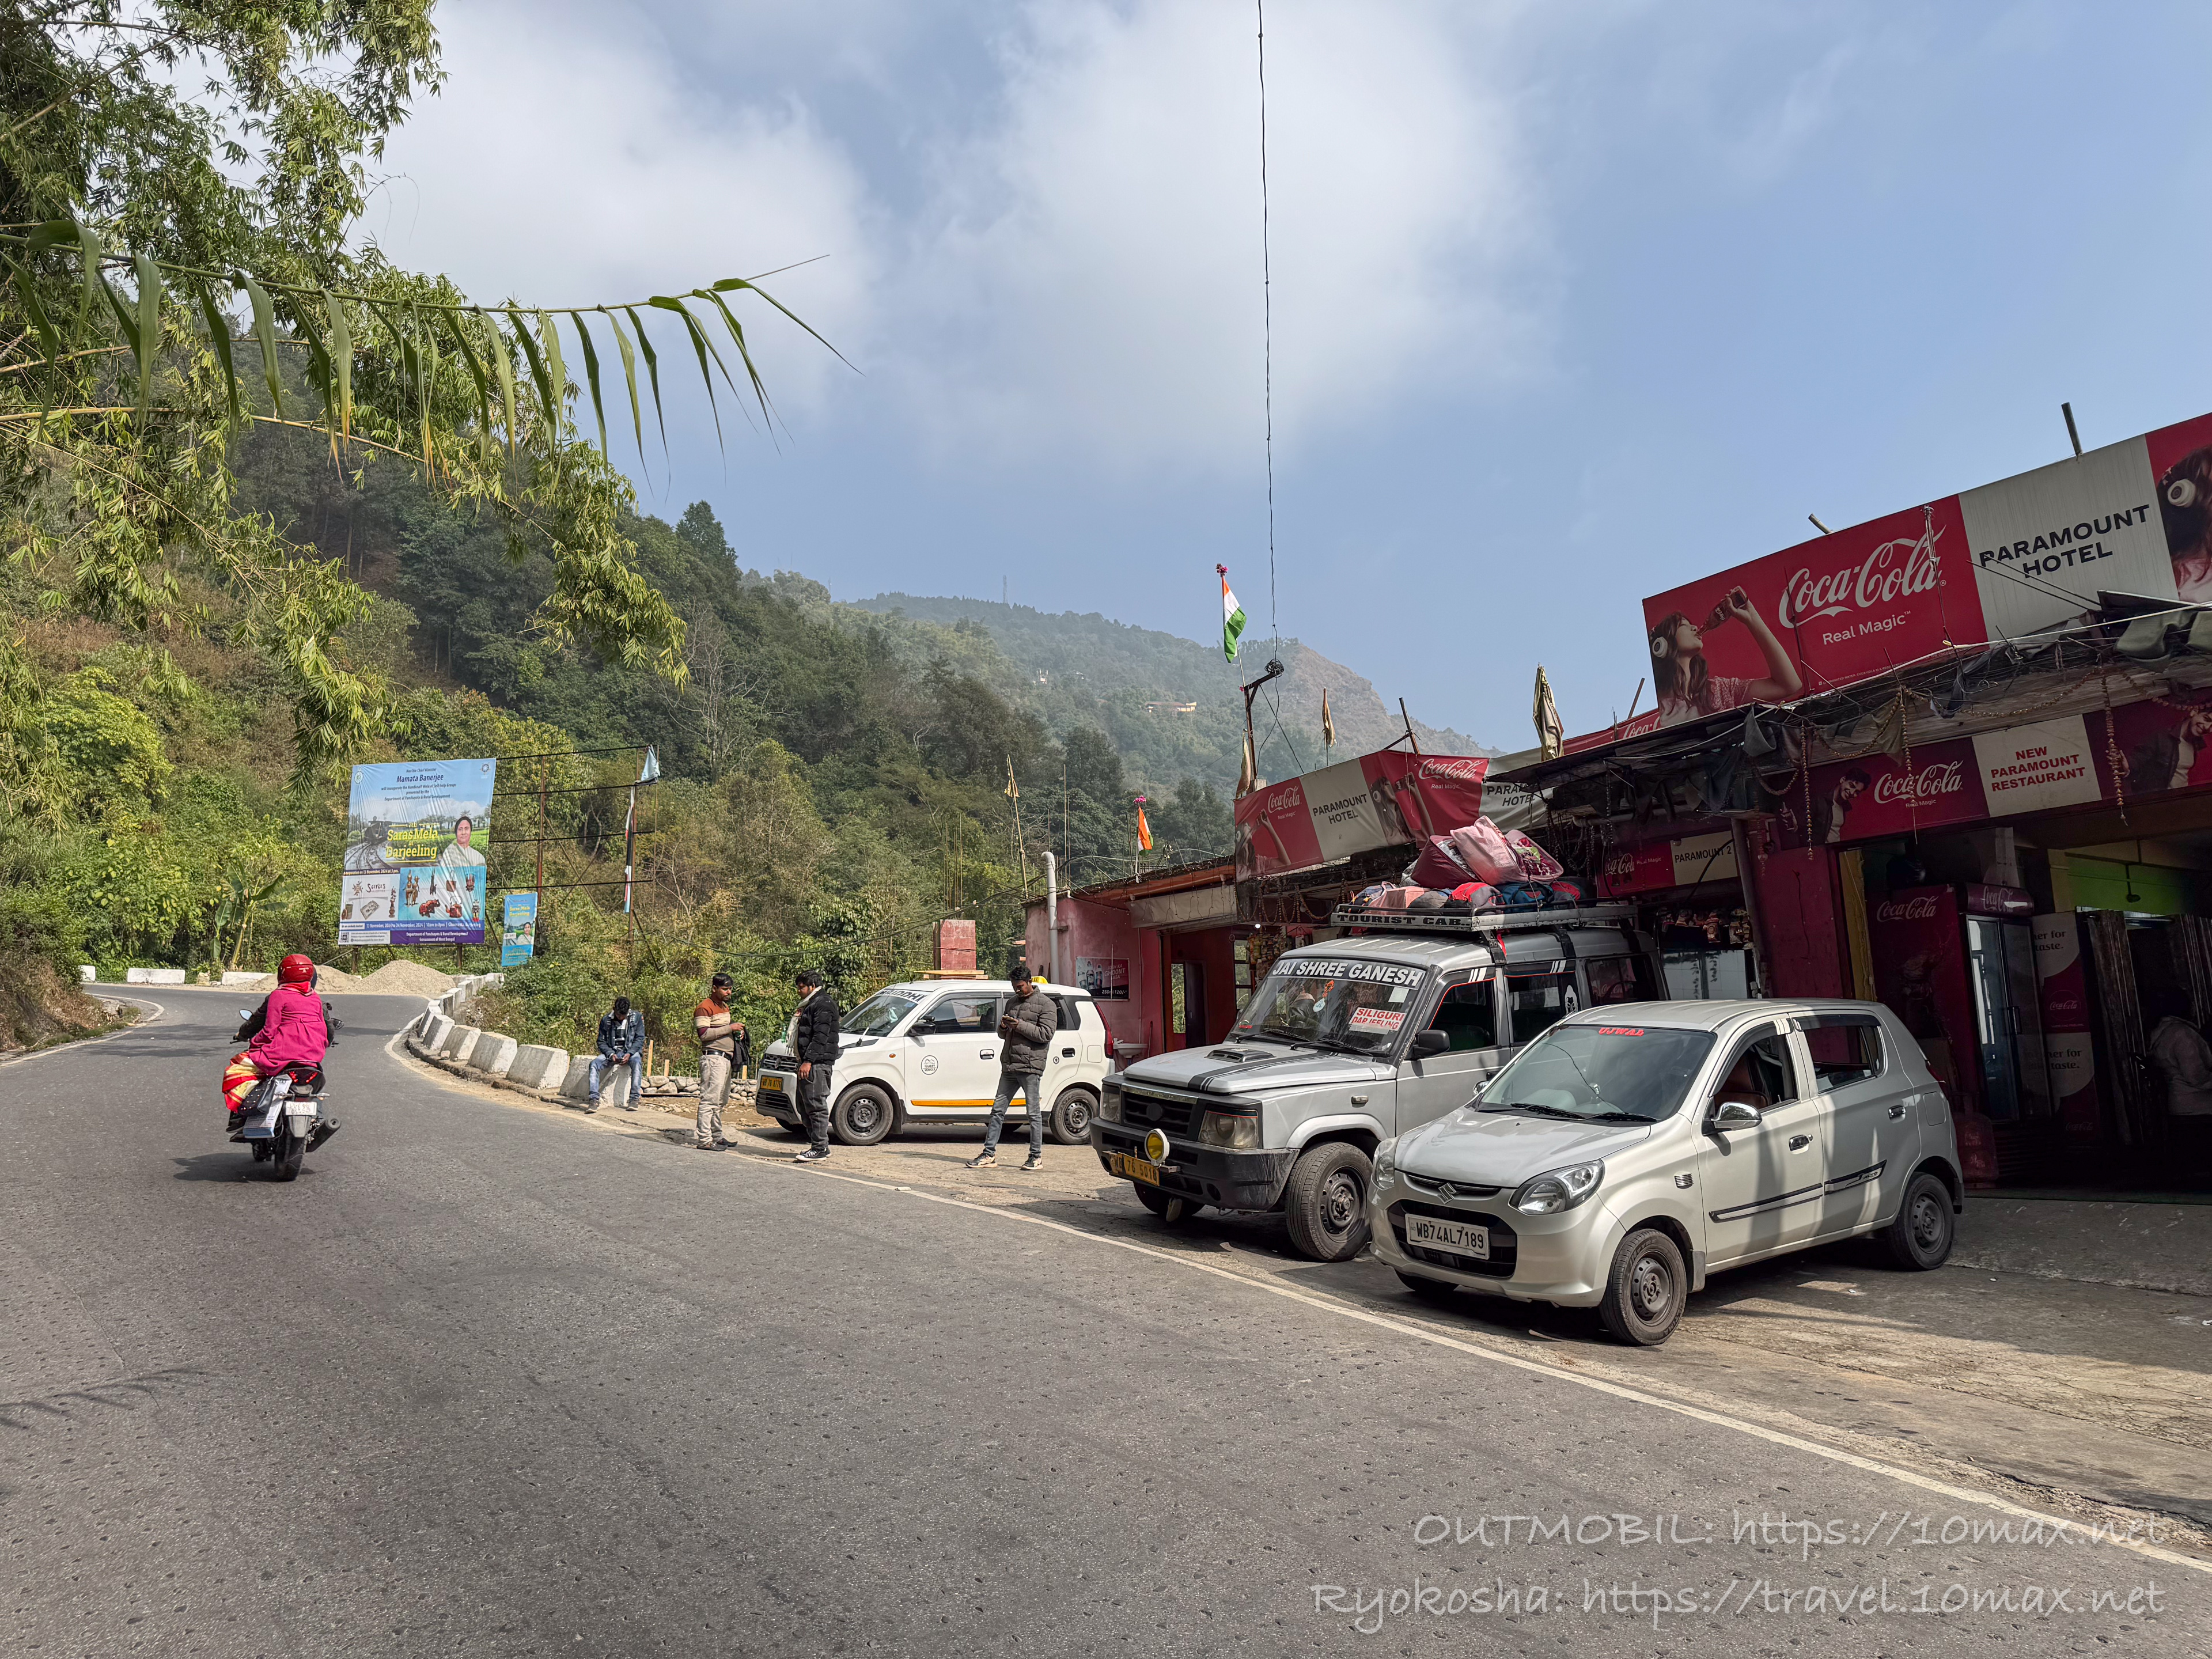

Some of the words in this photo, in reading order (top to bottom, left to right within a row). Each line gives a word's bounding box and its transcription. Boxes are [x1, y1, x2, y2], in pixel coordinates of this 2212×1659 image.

[1979, 504, 2149, 567] PARAMOUNT
[2022, 542, 2112, 578] HOTEL
[1779, 525, 1946, 628] Coca-Cola
[1823, 626, 1855, 645] Real
[2016, 746, 2047, 760] NEW
[1419, 759, 1484, 779] Coca-Cola
[1991, 754, 2079, 778] PARAMOUNT
[419, 774, 444, 783] Banerjee
[1874, 760, 1964, 804] Coca-Cola
[1991, 767, 2085, 791] RESTAURANT
[1268, 786, 1300, 813] Coca-Cola
[1312, 794, 1367, 817] PARAMOUNT
[1328, 810, 1359, 824] HOTEL
[387, 830, 413, 841] Saras
[414, 827, 438, 840] Mela
[386, 844, 437, 860] Darjeeling
[1675, 847, 1724, 863] PARAMOUNT
[1726, 846, 1732, 854] 2
[366, 883, 386, 893] Saras
[1877, 896, 1940, 923] Coca-Cola
[1337, 915, 1416, 925] TOURIST
[1272, 961, 1298, 975] JAI
[1296, 961, 1349, 977] SHREE
[1349, 964, 1423, 986] GANESH
[1357, 1008, 1404, 1021] SILIGURI
[2067, 1049, 2082, 1057] for
[1416, 1222, 1484, 1249] WB74AL7189
